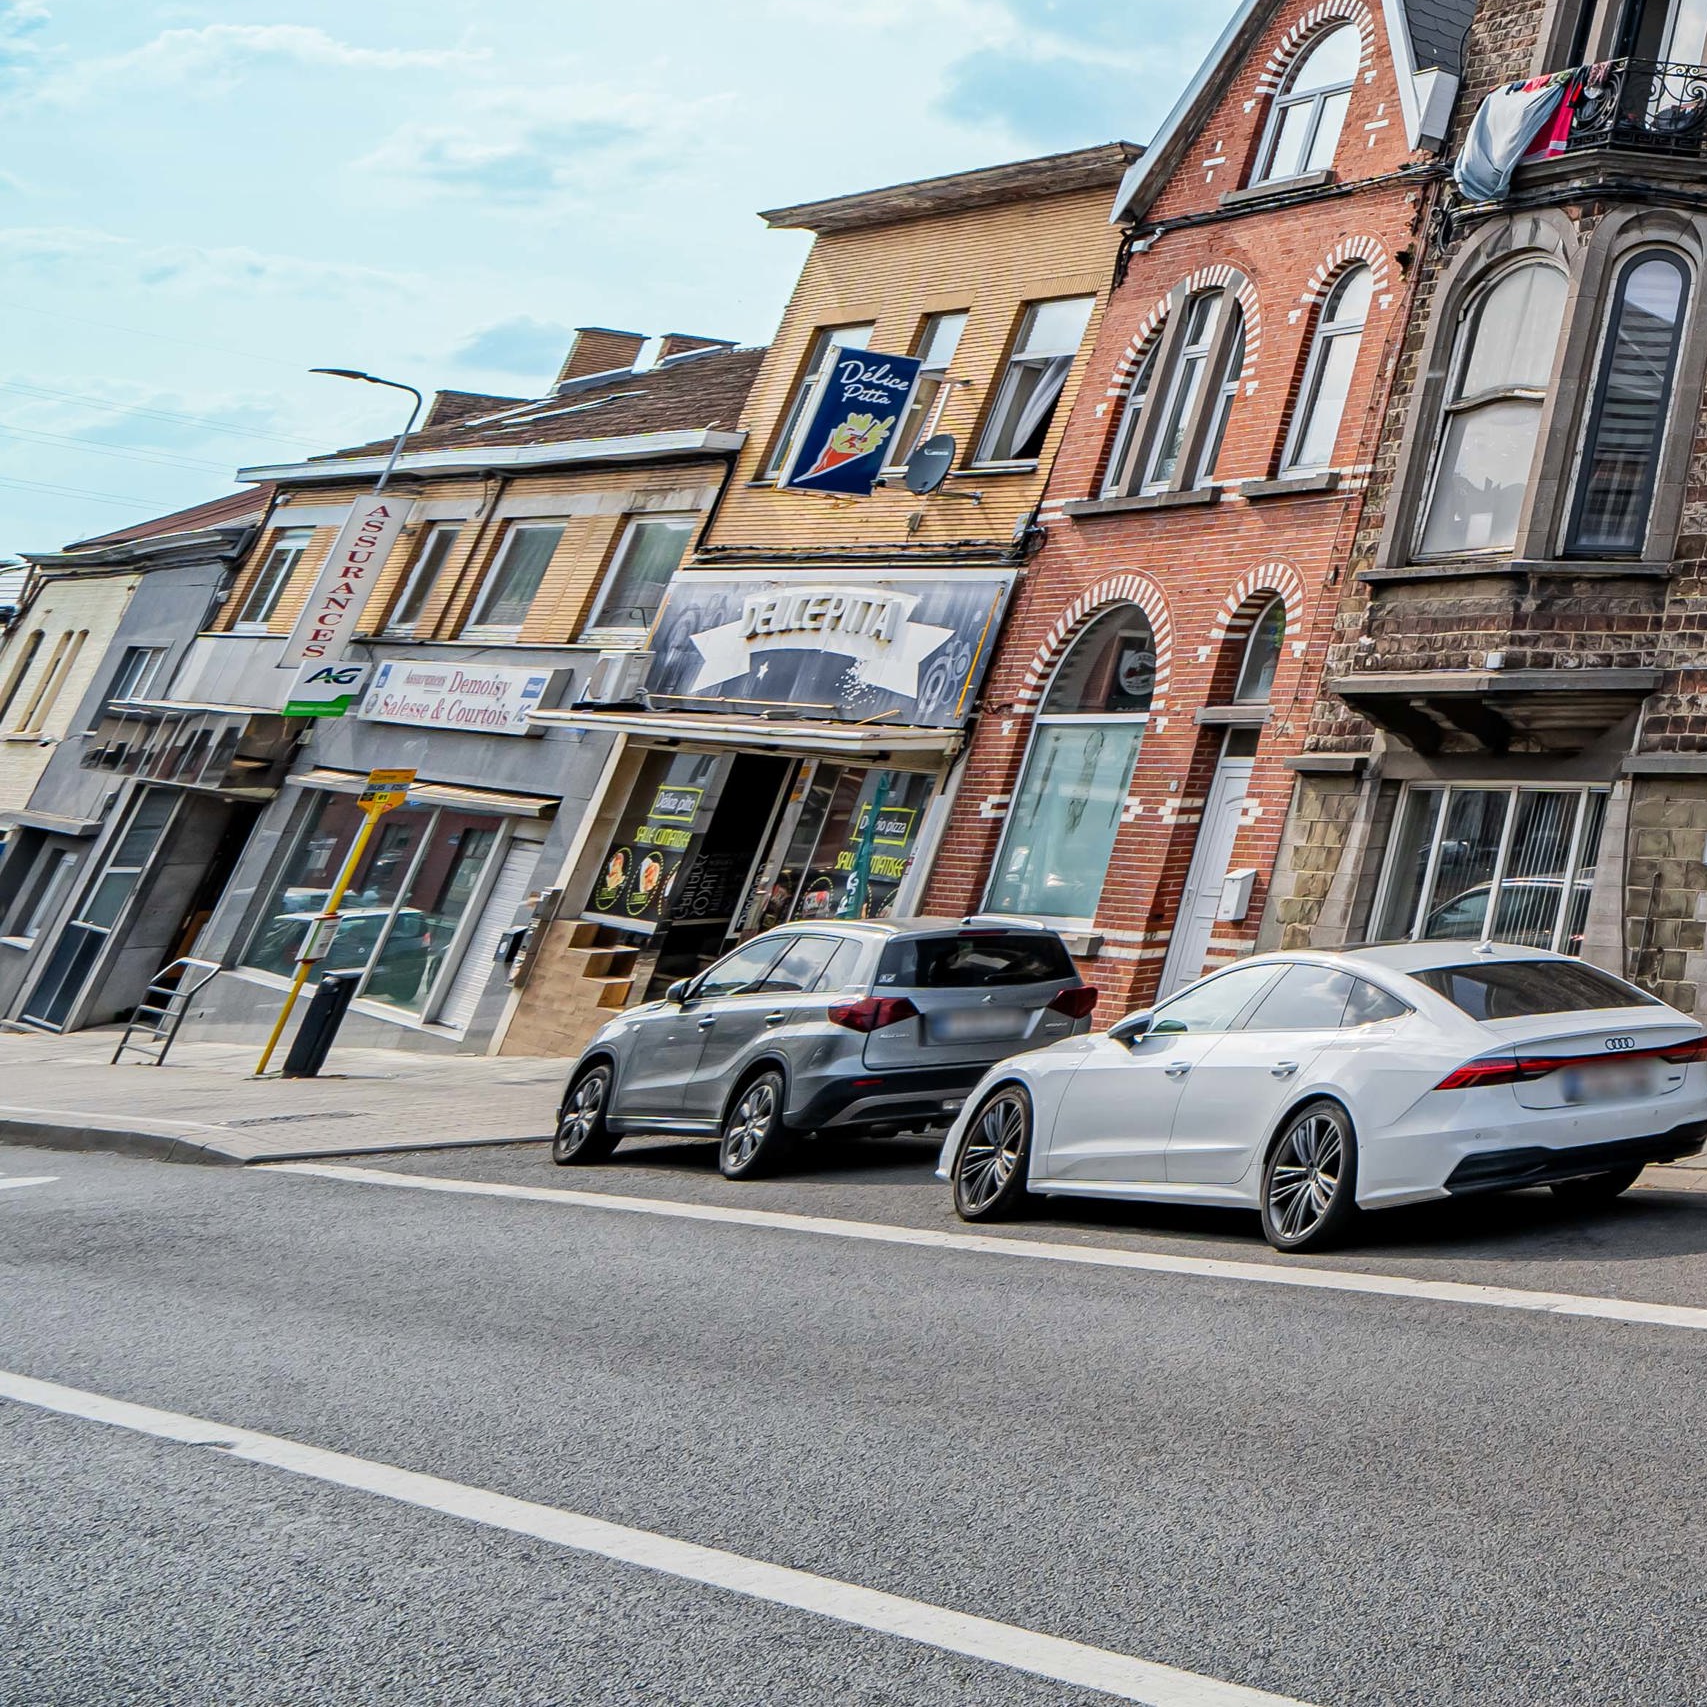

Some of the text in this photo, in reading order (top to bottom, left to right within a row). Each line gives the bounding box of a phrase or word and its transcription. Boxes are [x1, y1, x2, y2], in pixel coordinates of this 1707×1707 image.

[839, 360, 910, 391] Délice
[842, 384, 892, 405] Pitta
[302, 505, 391, 658] ASSURANCES
[303, 667, 363, 684] AG
[447, 671, 512, 702] Demoisy
[378, 693, 511, 726] Salesse & Courtois
